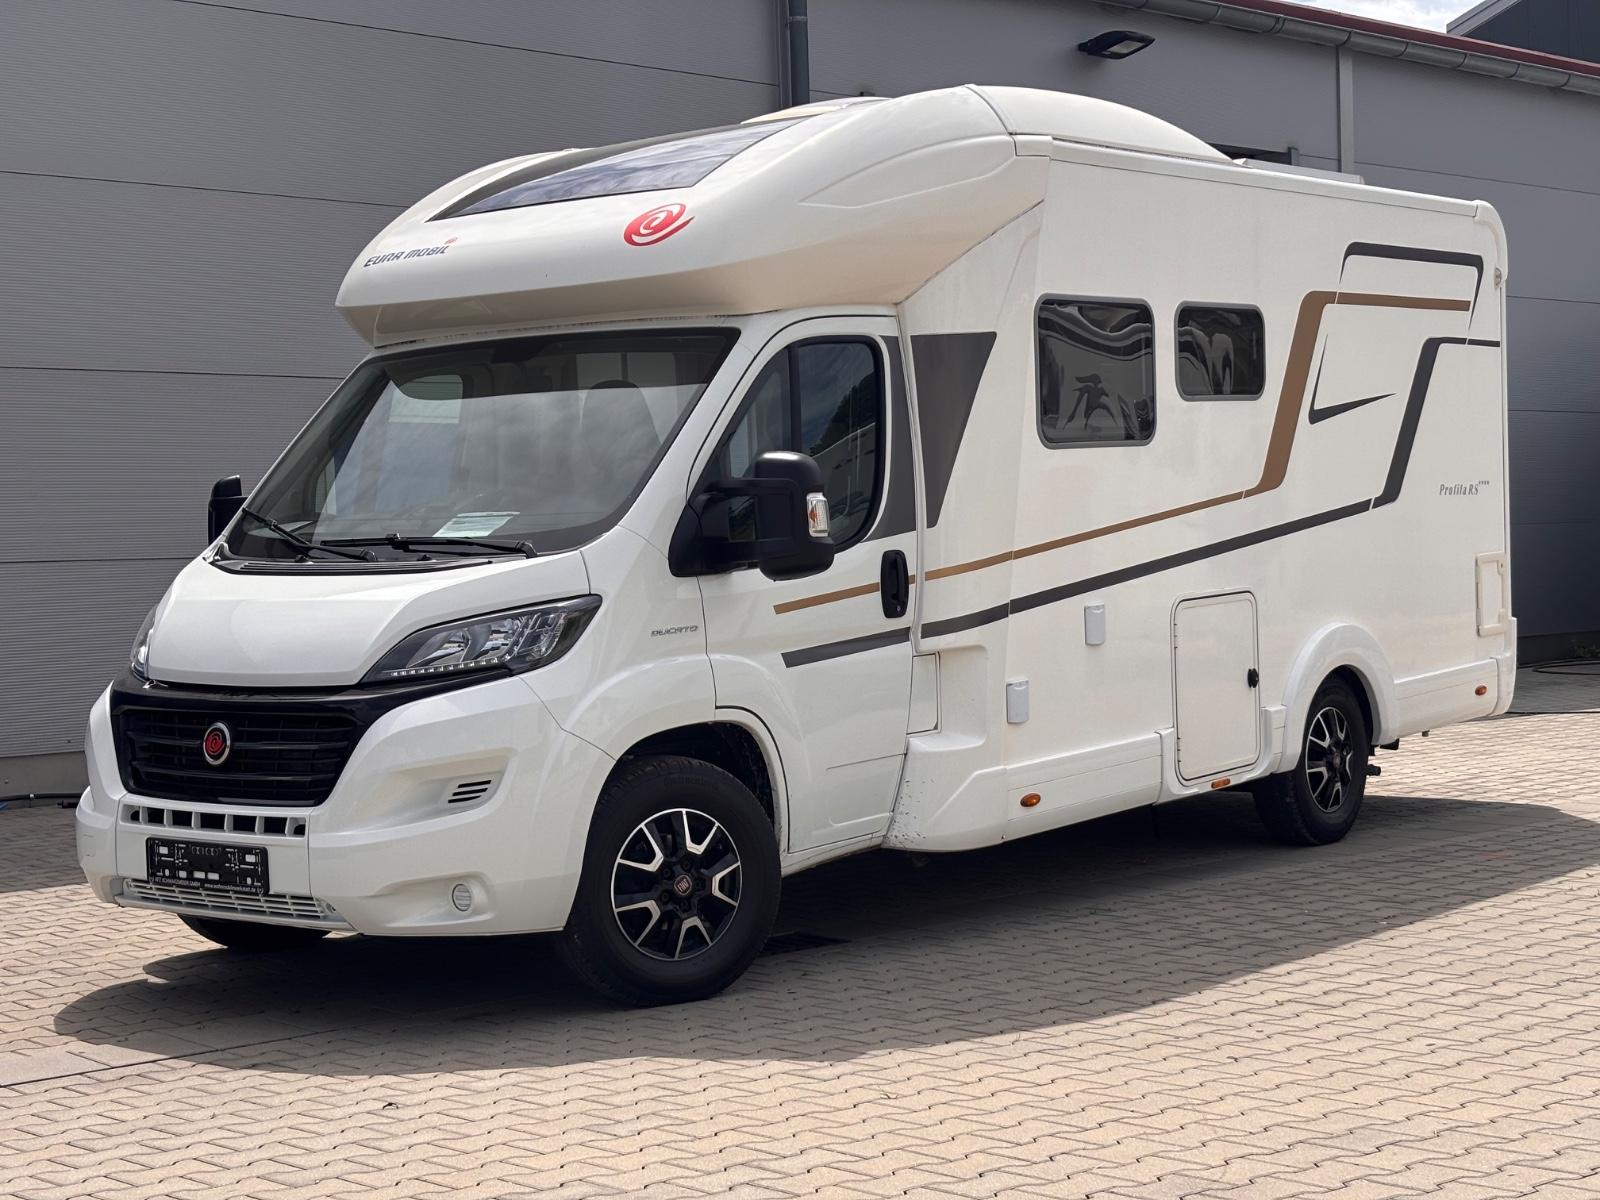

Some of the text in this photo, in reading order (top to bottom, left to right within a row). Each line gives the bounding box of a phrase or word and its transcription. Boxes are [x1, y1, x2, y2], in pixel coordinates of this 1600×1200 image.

[363, 245, 449, 267] EURA MOBIL
[1468, 483, 1479, 496] RS
[651, 624, 698, 637] DUCATO
